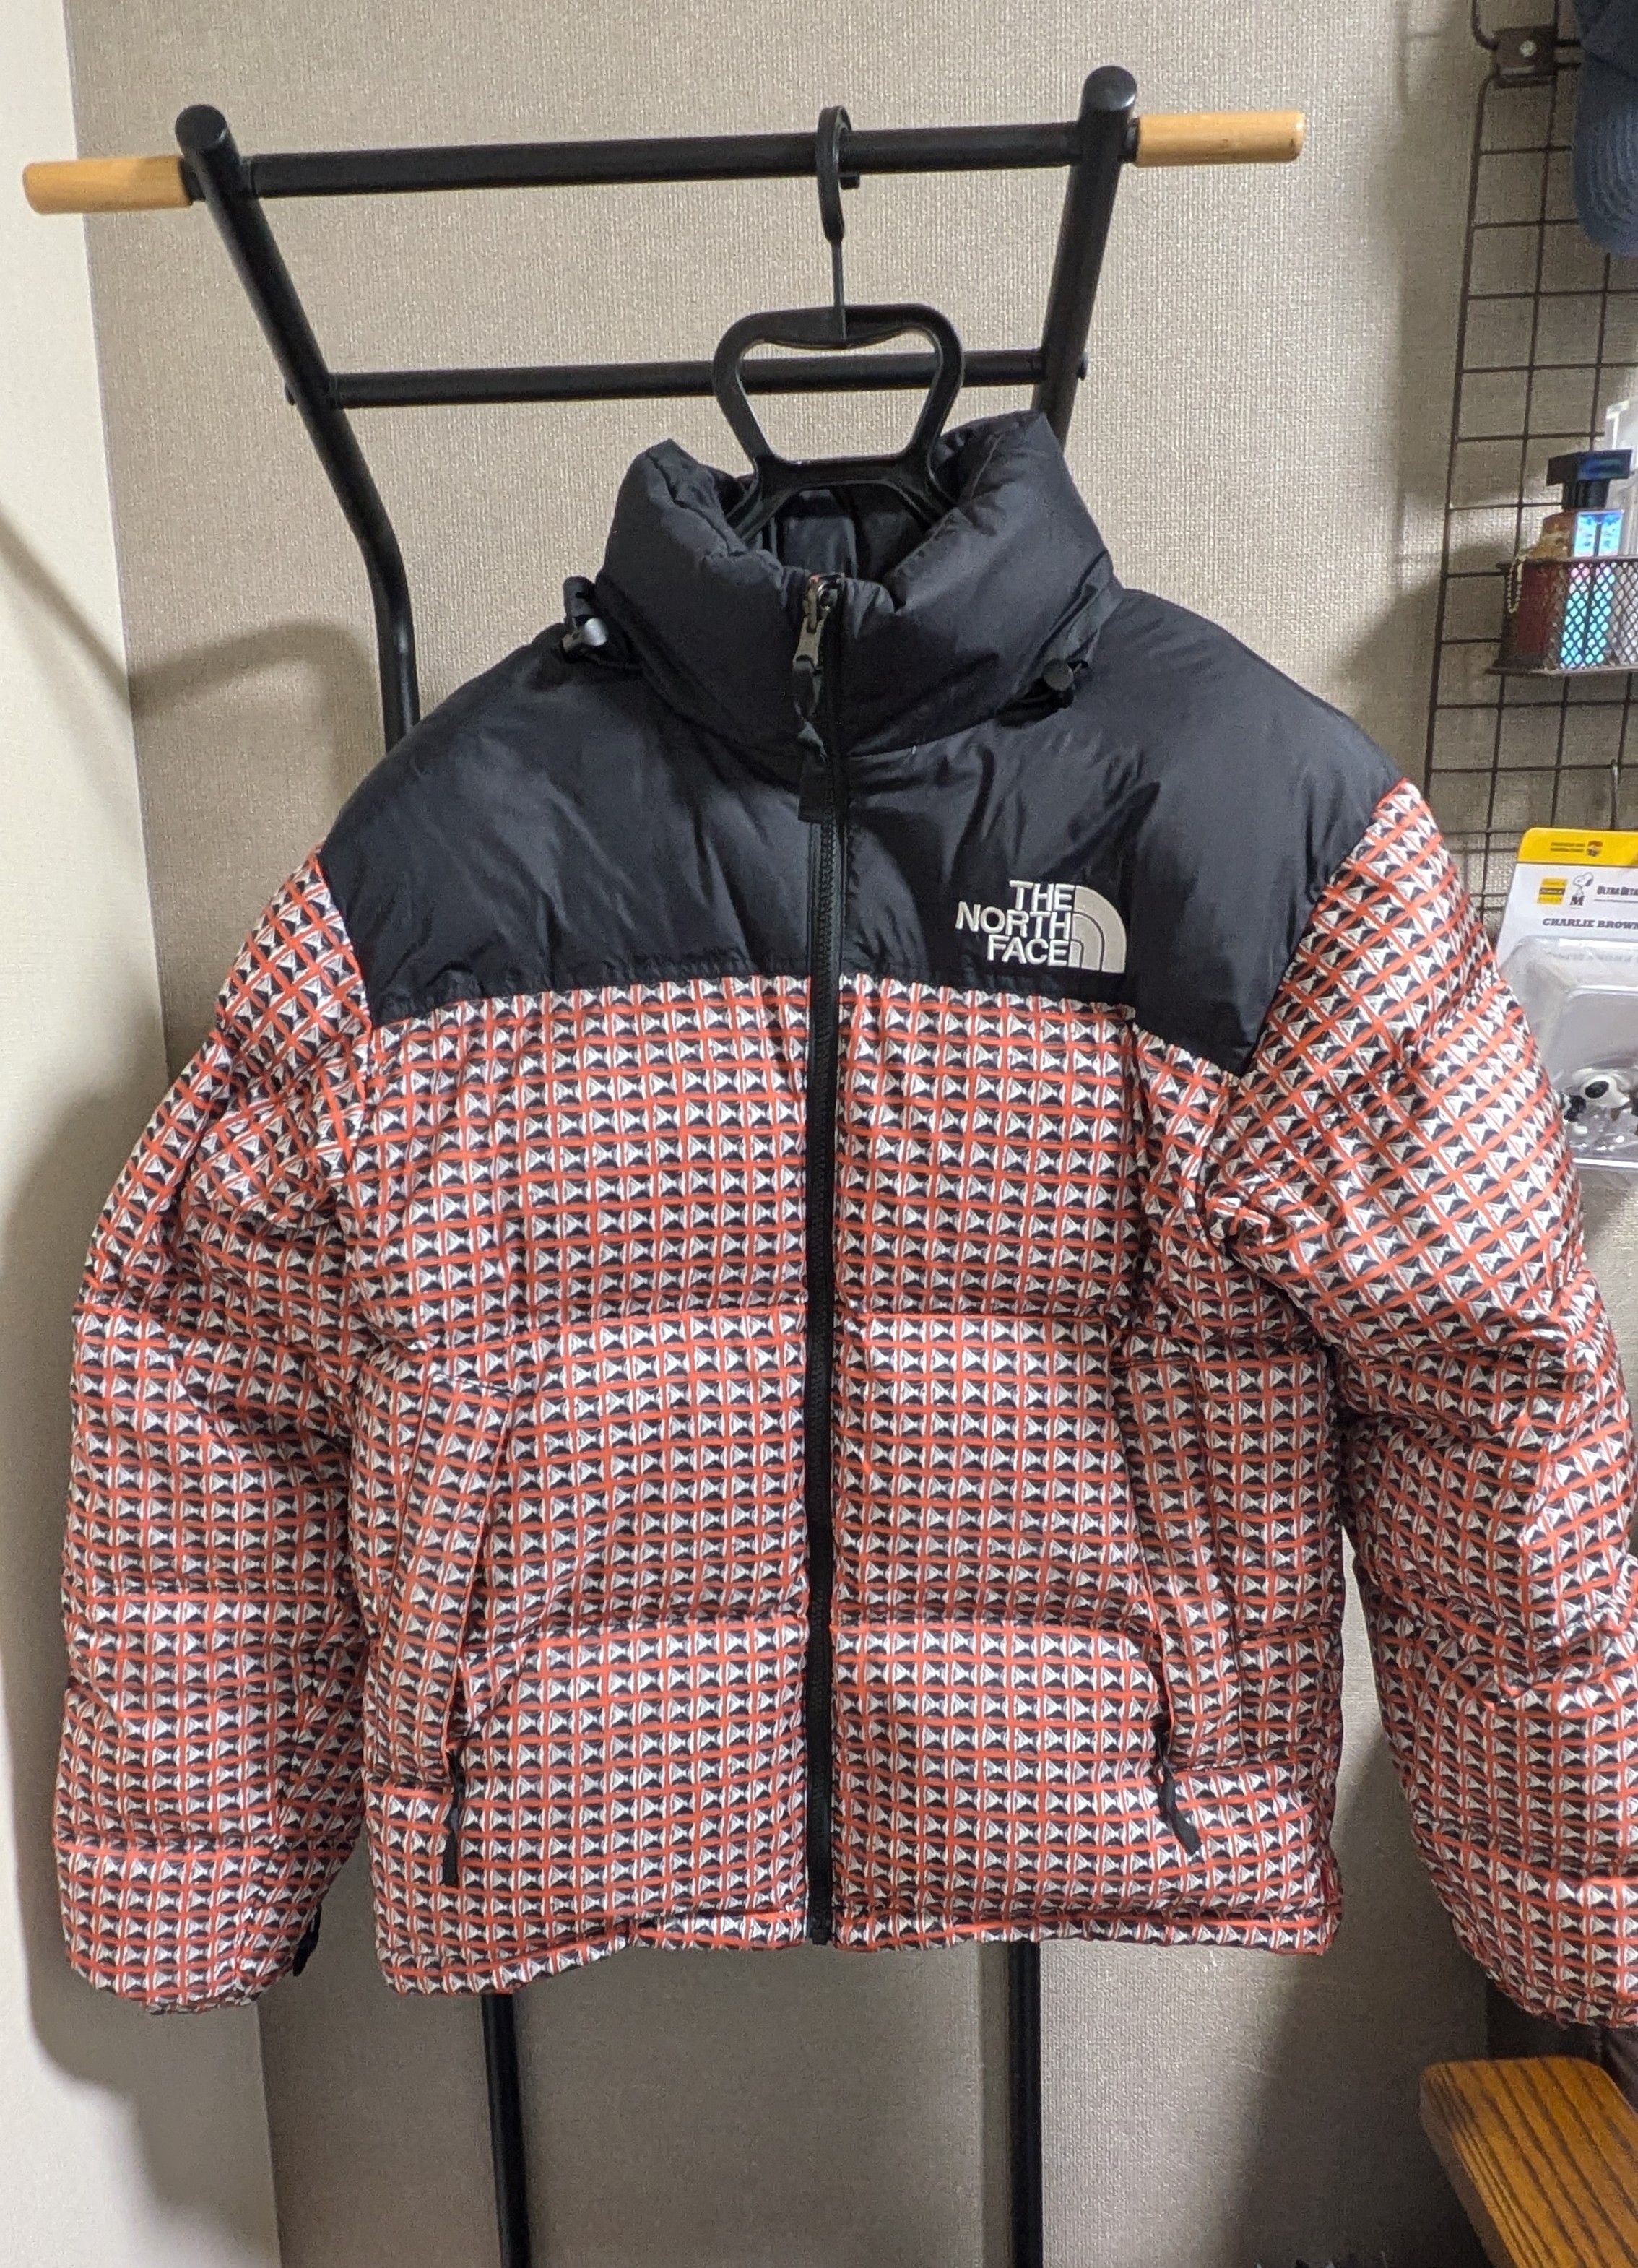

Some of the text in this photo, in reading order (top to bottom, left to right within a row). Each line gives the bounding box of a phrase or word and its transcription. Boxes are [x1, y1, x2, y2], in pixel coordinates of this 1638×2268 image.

[1008, 880, 1075, 912] THE
[956, 901, 1072, 940] NORTH
[1542, 917, 1595, 927] CHARLIE
[986, 934, 1070, 966] FACE
